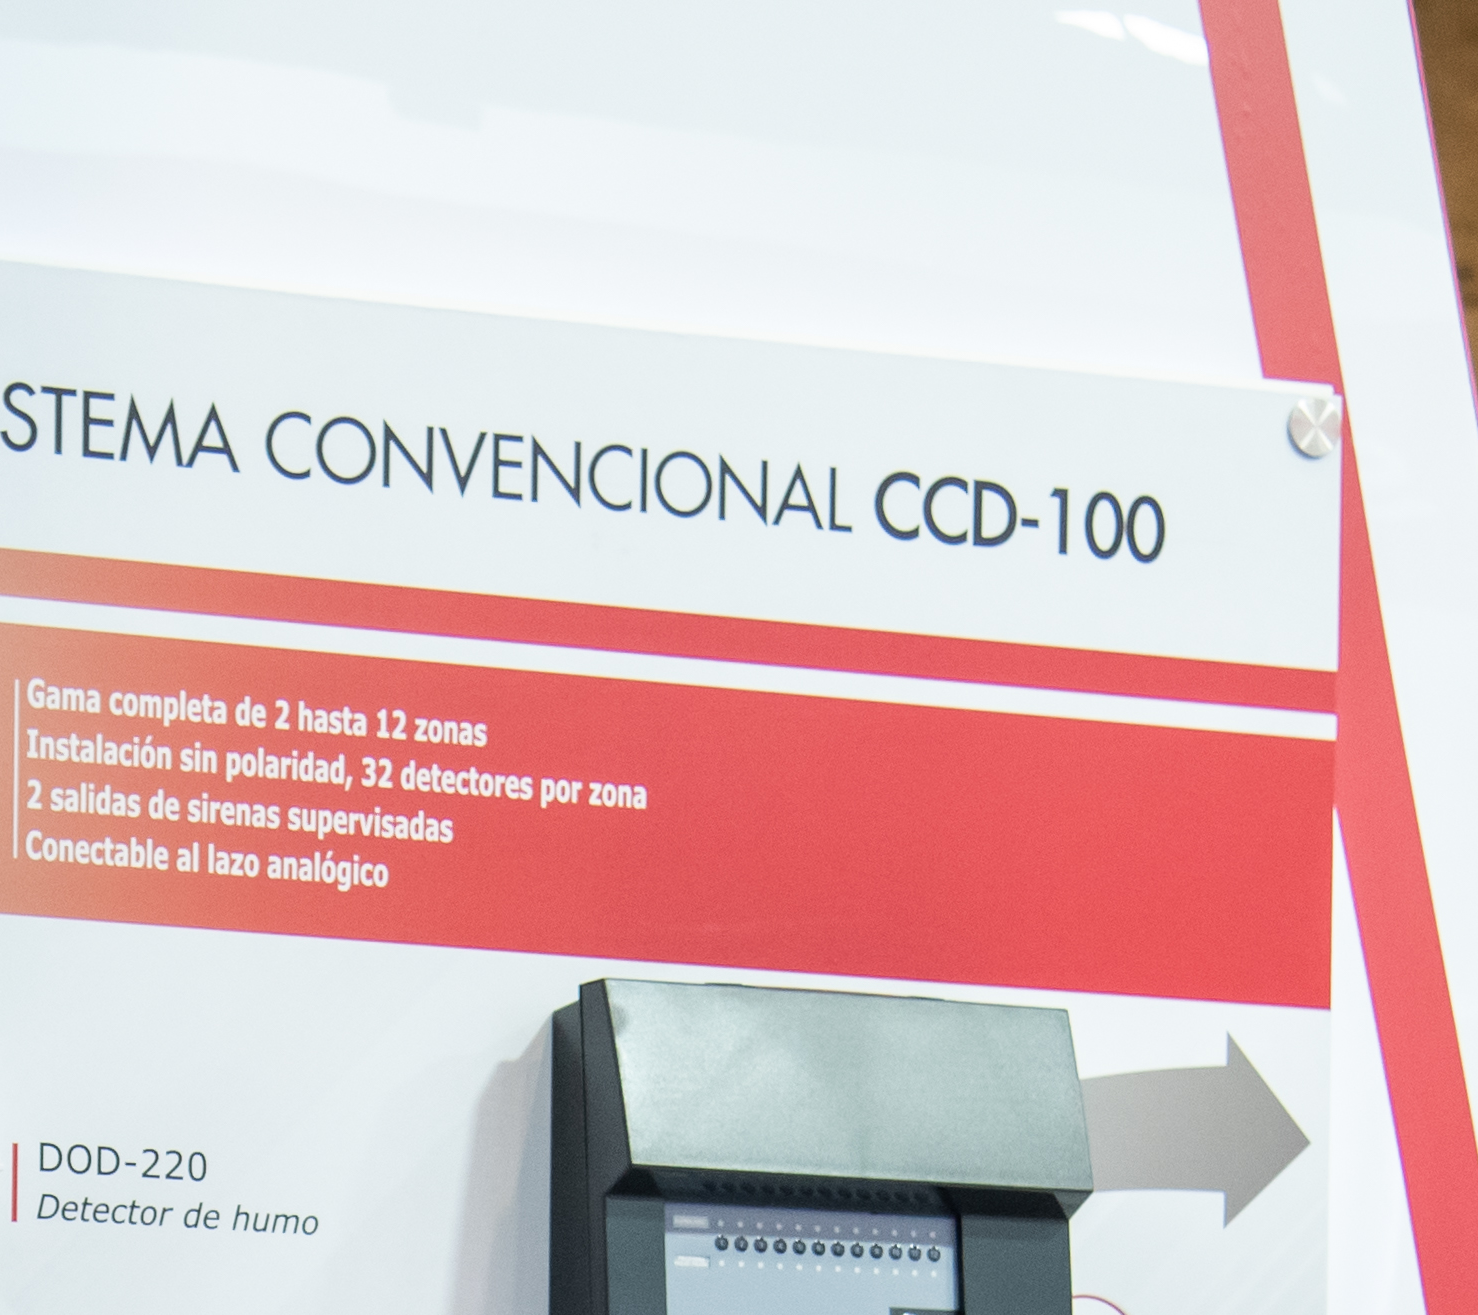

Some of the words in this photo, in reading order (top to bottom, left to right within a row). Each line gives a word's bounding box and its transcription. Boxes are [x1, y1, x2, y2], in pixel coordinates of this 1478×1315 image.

[265, 410, 853, 533] CONVENCIONAL
[874, 471, 1166, 564] CCD-100
[26, 677, 102, 714] Gama
[108, 689, 228, 728] completa
[234, 695, 267, 729] de
[274, 699, 291, 731] 2
[297, 700, 368, 737] hasta
[376, 708, 408, 741] 12
[413, 718, 488, 748] zonas
[26, 727, 173, 770] Instalación
[179, 741, 218, 774] sin
[225, 746, 353, 791] polaridad,
[360, 756, 394, 789] 32
[399, 759, 534, 801] detectores
[540, 778, 583, 809] por
[588, 782, 648, 810] zona
[26, 778, 43, 810] 2
[49, 782, 142, 818] salidas
[147, 788, 181, 822] de
[186, 792, 281, 830] sirenas
[287, 806, 454, 844] supervisadas
[24, 829, 170, 871] Conectable
[175, 841, 200, 873] al
[207, 842, 261, 878] lazo
[266, 850, 390, 893] analógico
[39, 1141, 208, 1183] DOD-220
[36, 1192, 174, 1227] Detector
[182, 1201, 221, 1231] de
[231, 1204, 320, 1236] humo
